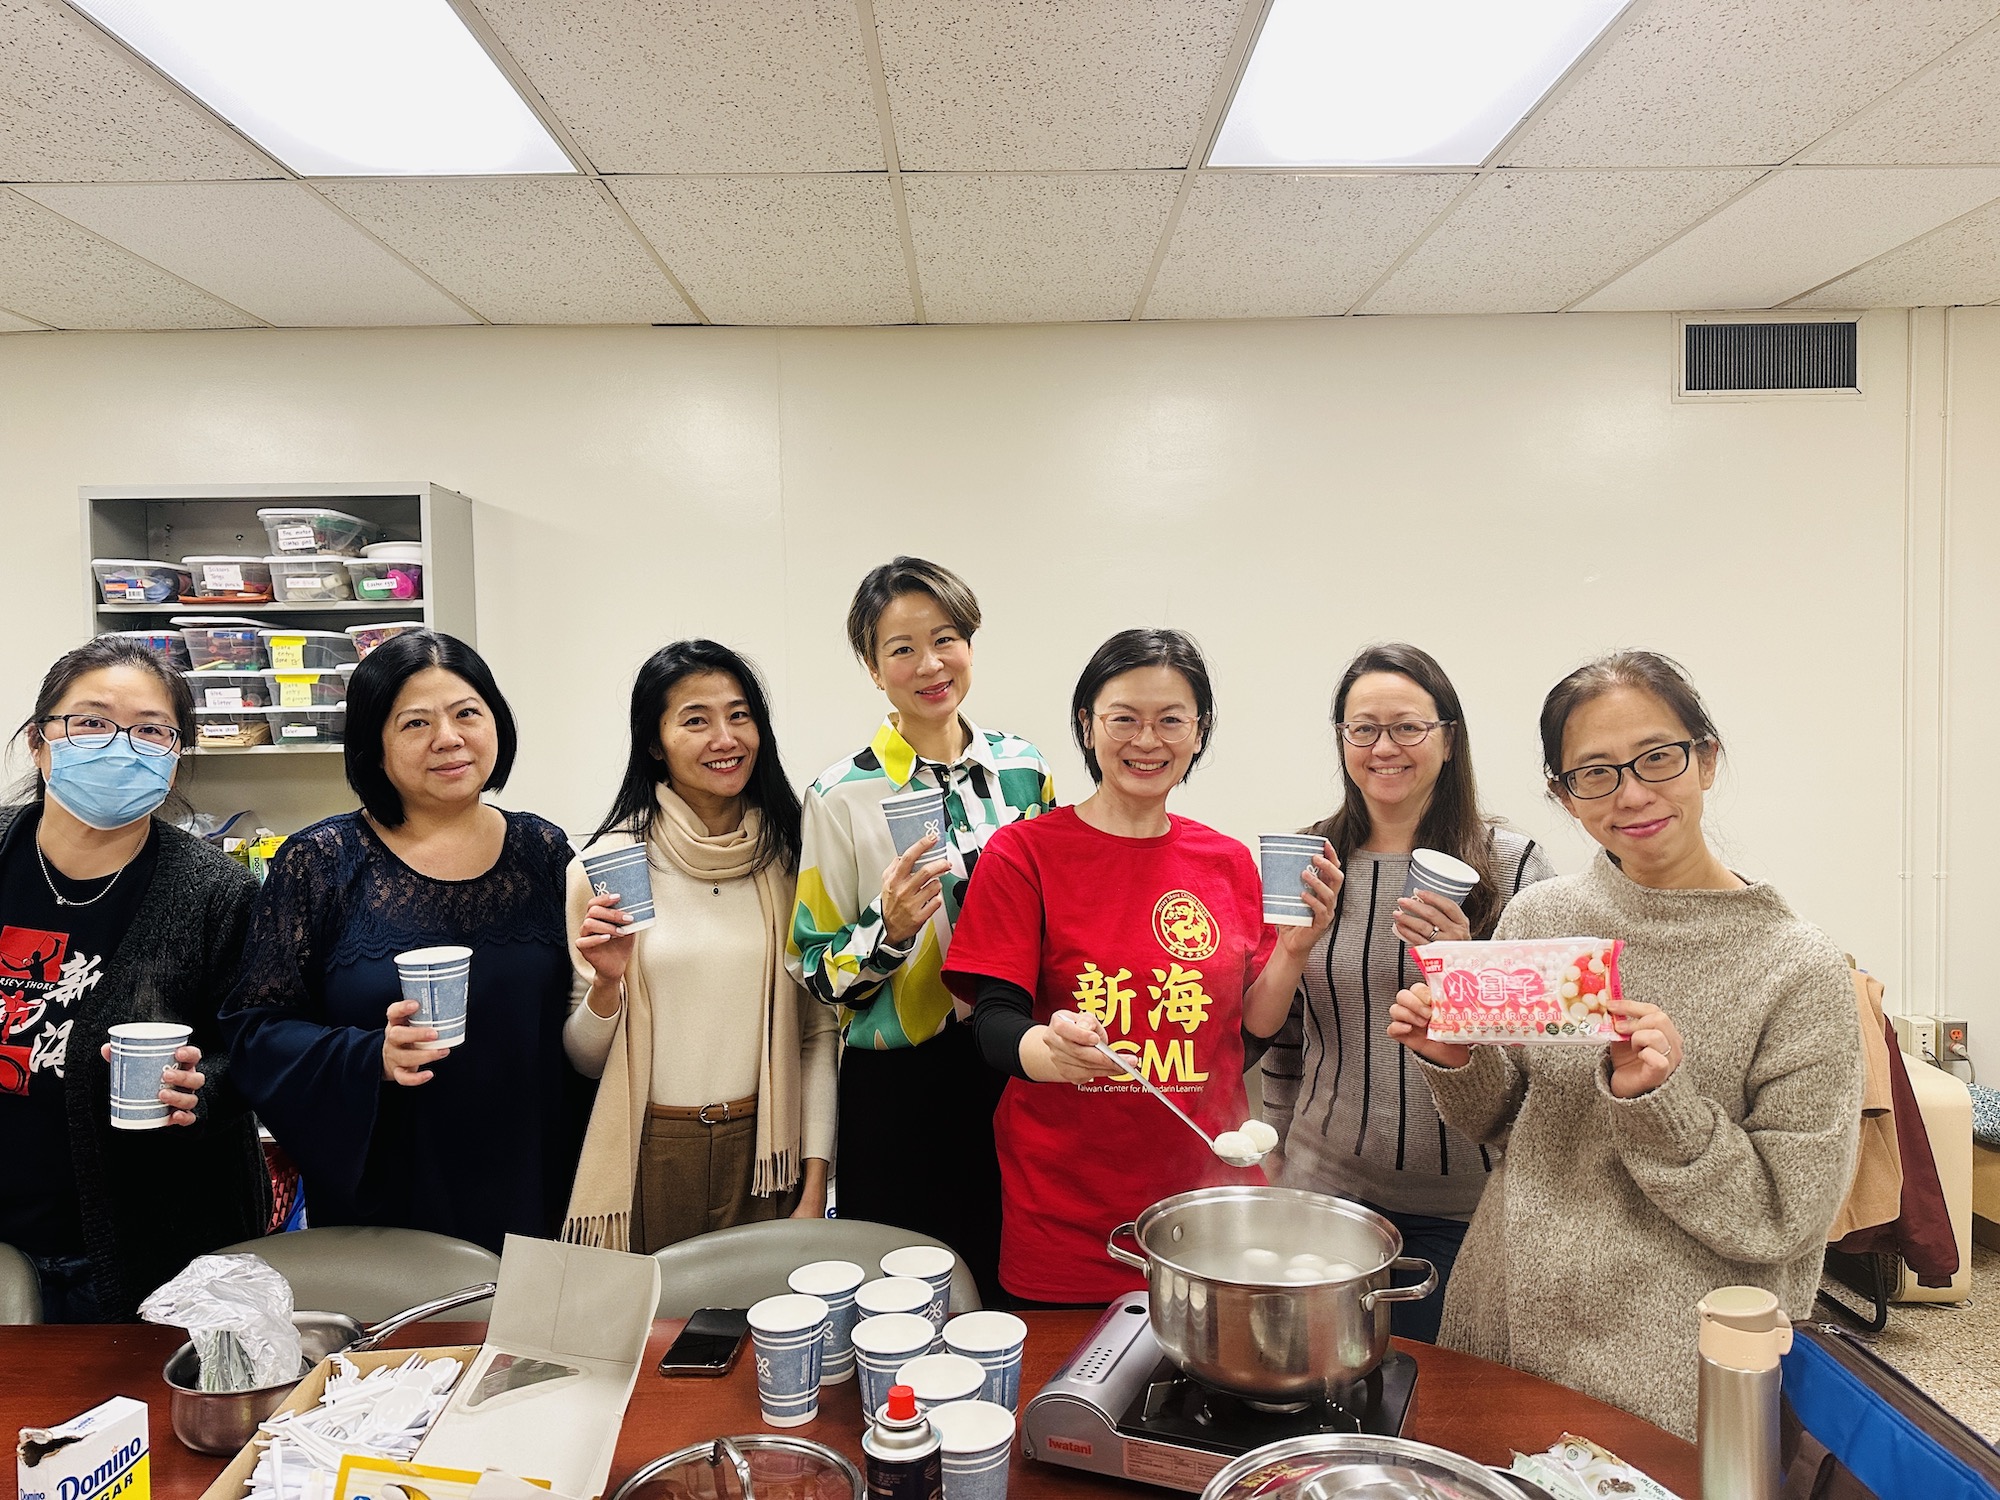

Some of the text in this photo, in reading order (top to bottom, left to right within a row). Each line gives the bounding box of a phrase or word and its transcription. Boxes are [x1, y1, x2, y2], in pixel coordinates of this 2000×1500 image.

[25, 982, 56, 991] SHORE
[1441, 1010, 1561, 1021] Small Sweet Rice Ball
[1088, 1038, 1210, 1083] CML
[1103, 1084, 1128, 1093] Center
[1130, 1084, 1141, 1093] for
[1048, 1438, 1092, 1455] Iwatani
[57, 1437, 141, 1500] Domino
